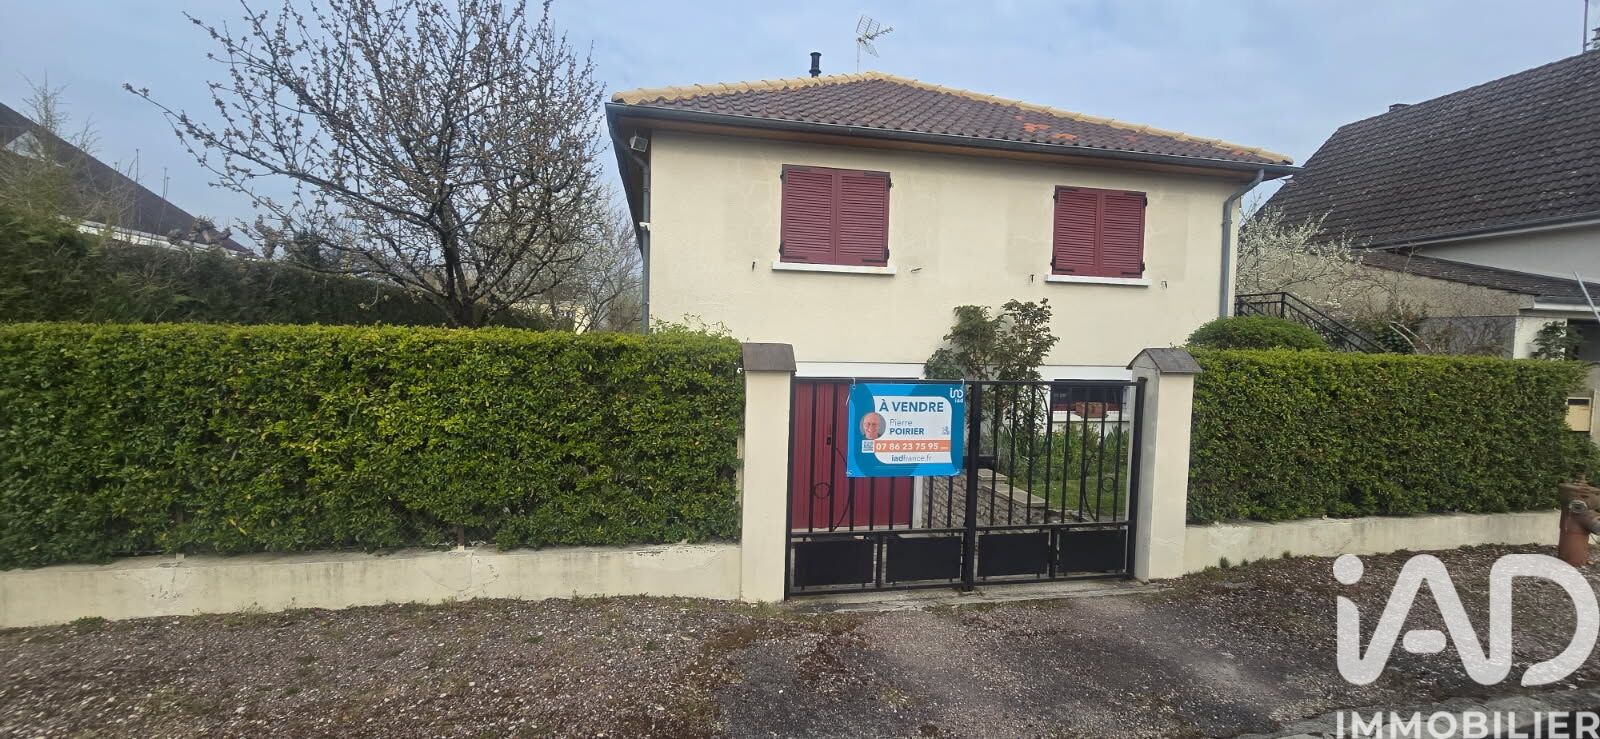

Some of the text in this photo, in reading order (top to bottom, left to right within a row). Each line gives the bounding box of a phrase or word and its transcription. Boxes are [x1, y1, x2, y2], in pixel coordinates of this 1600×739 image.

[879, 399, 944, 412] À VENDRE
[889, 418, 913, 426] Pierre
[889, 427, 925, 435] POIRIER
[889, 442, 901, 450] 86
[902, 442, 913, 450] 23
[915, 442, 926, 450] 75
[928, 442, 939, 450] 95
[891, 453, 932, 462] iadfrance.fr
